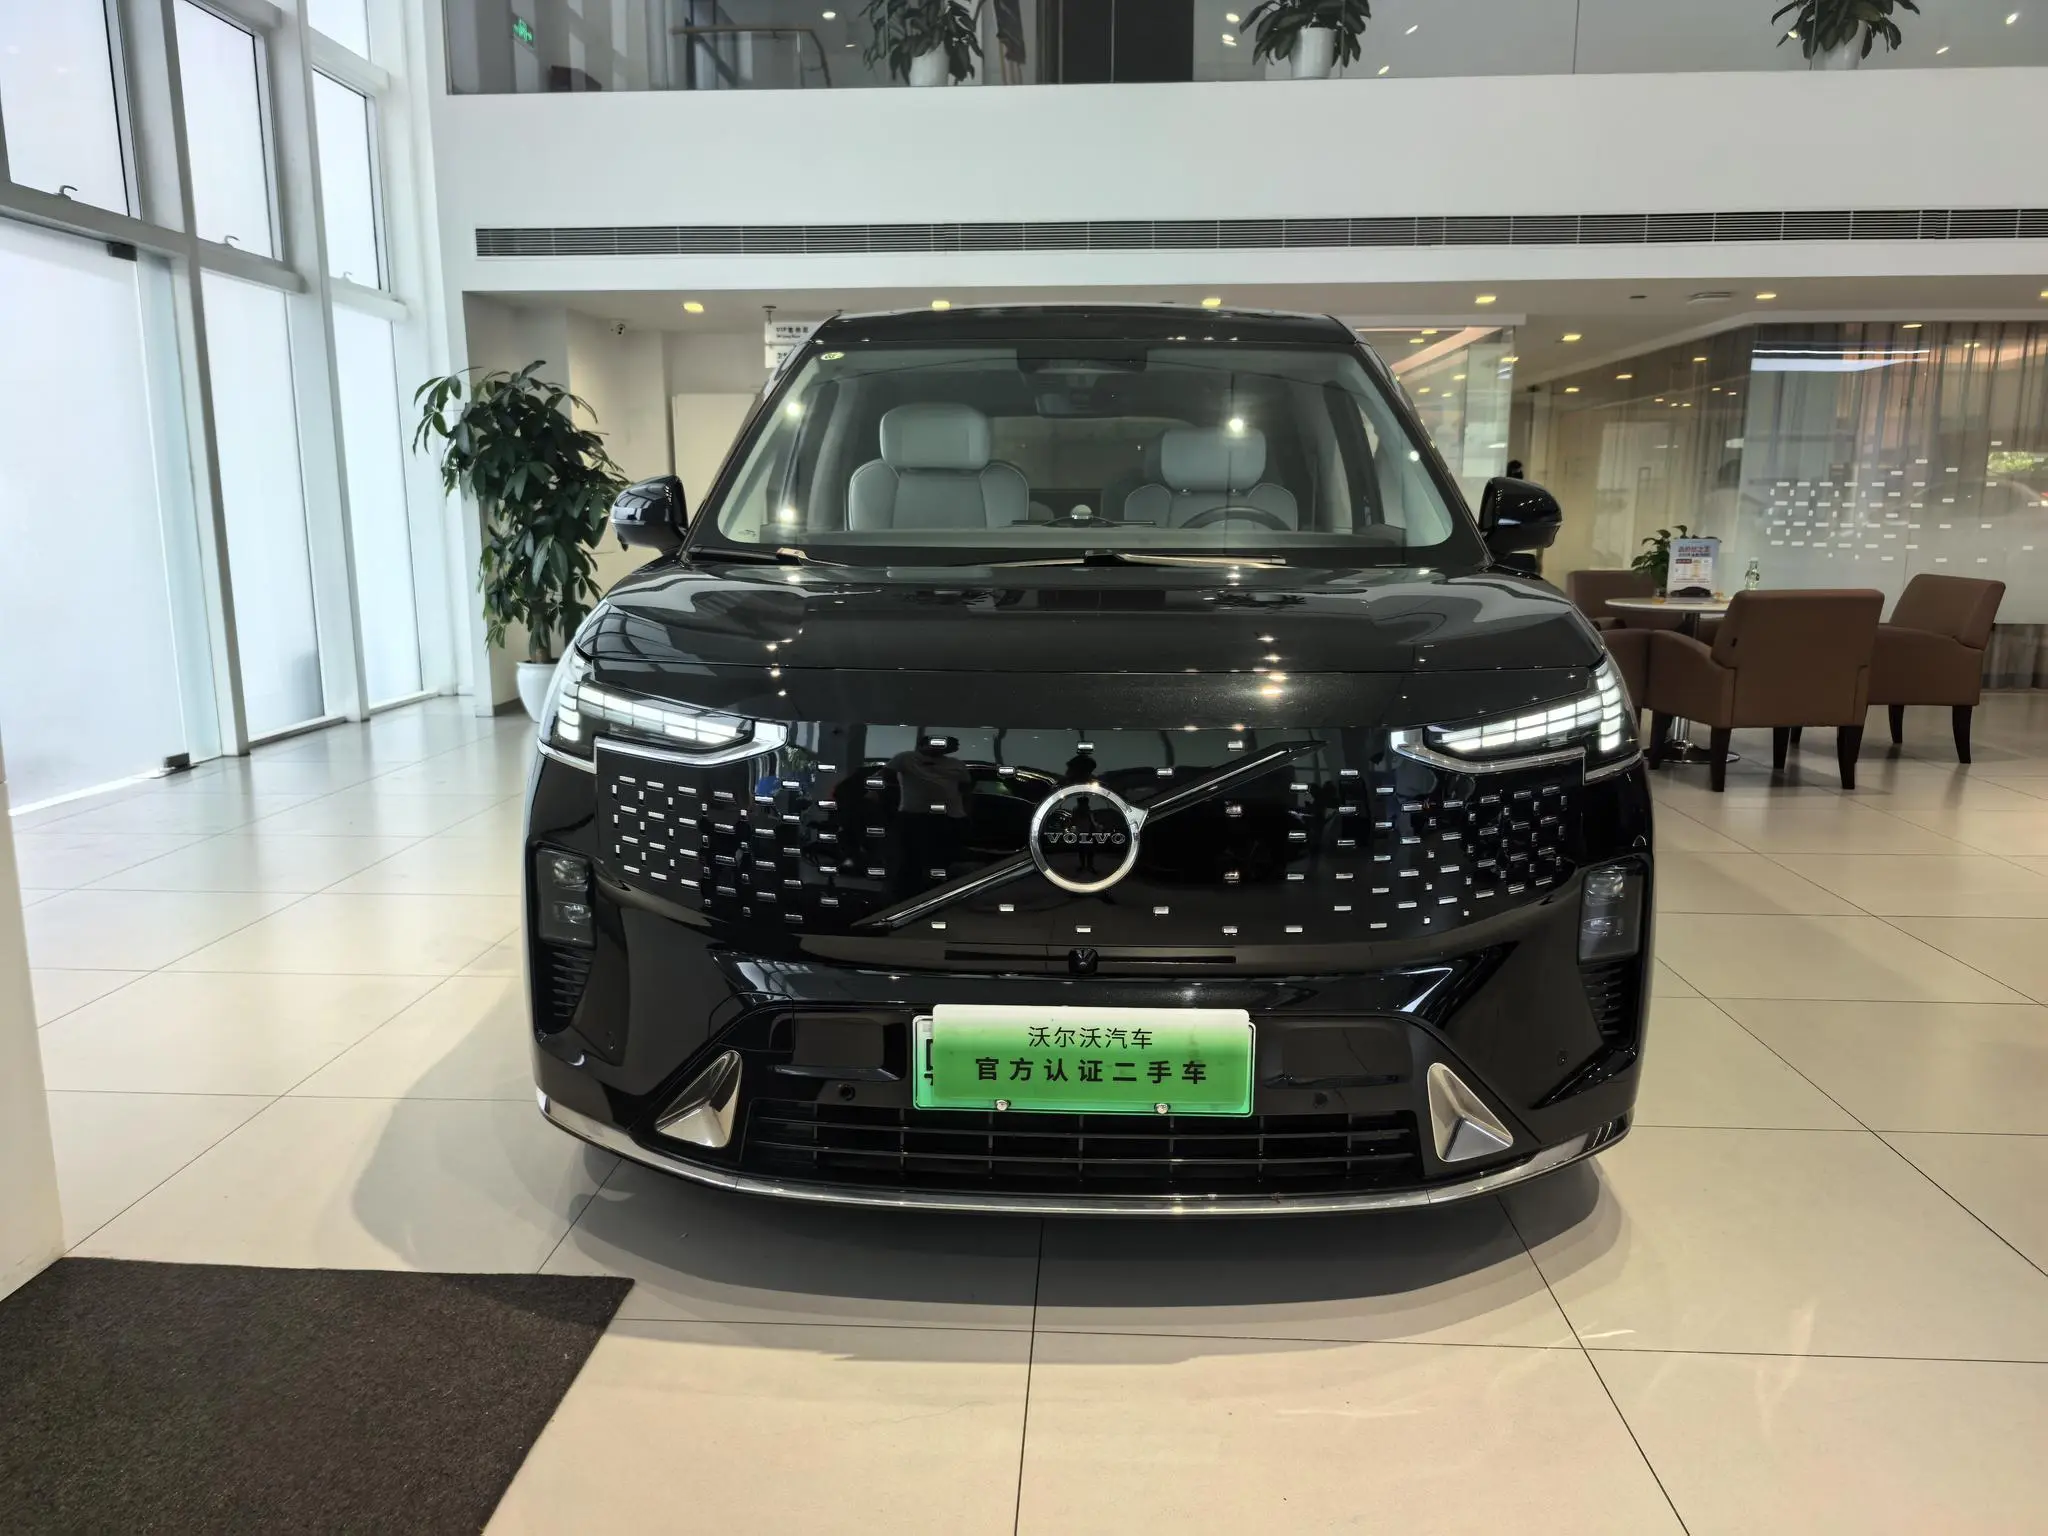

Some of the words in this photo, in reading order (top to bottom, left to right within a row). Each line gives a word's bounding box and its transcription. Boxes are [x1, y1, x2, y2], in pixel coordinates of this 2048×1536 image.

[1044, 832, 1126, 845] VOLVO
[1028, 1026, 1153, 1049] 沃尔沃汽车
[975, 1057, 1207, 1085] 官方认证二手车
